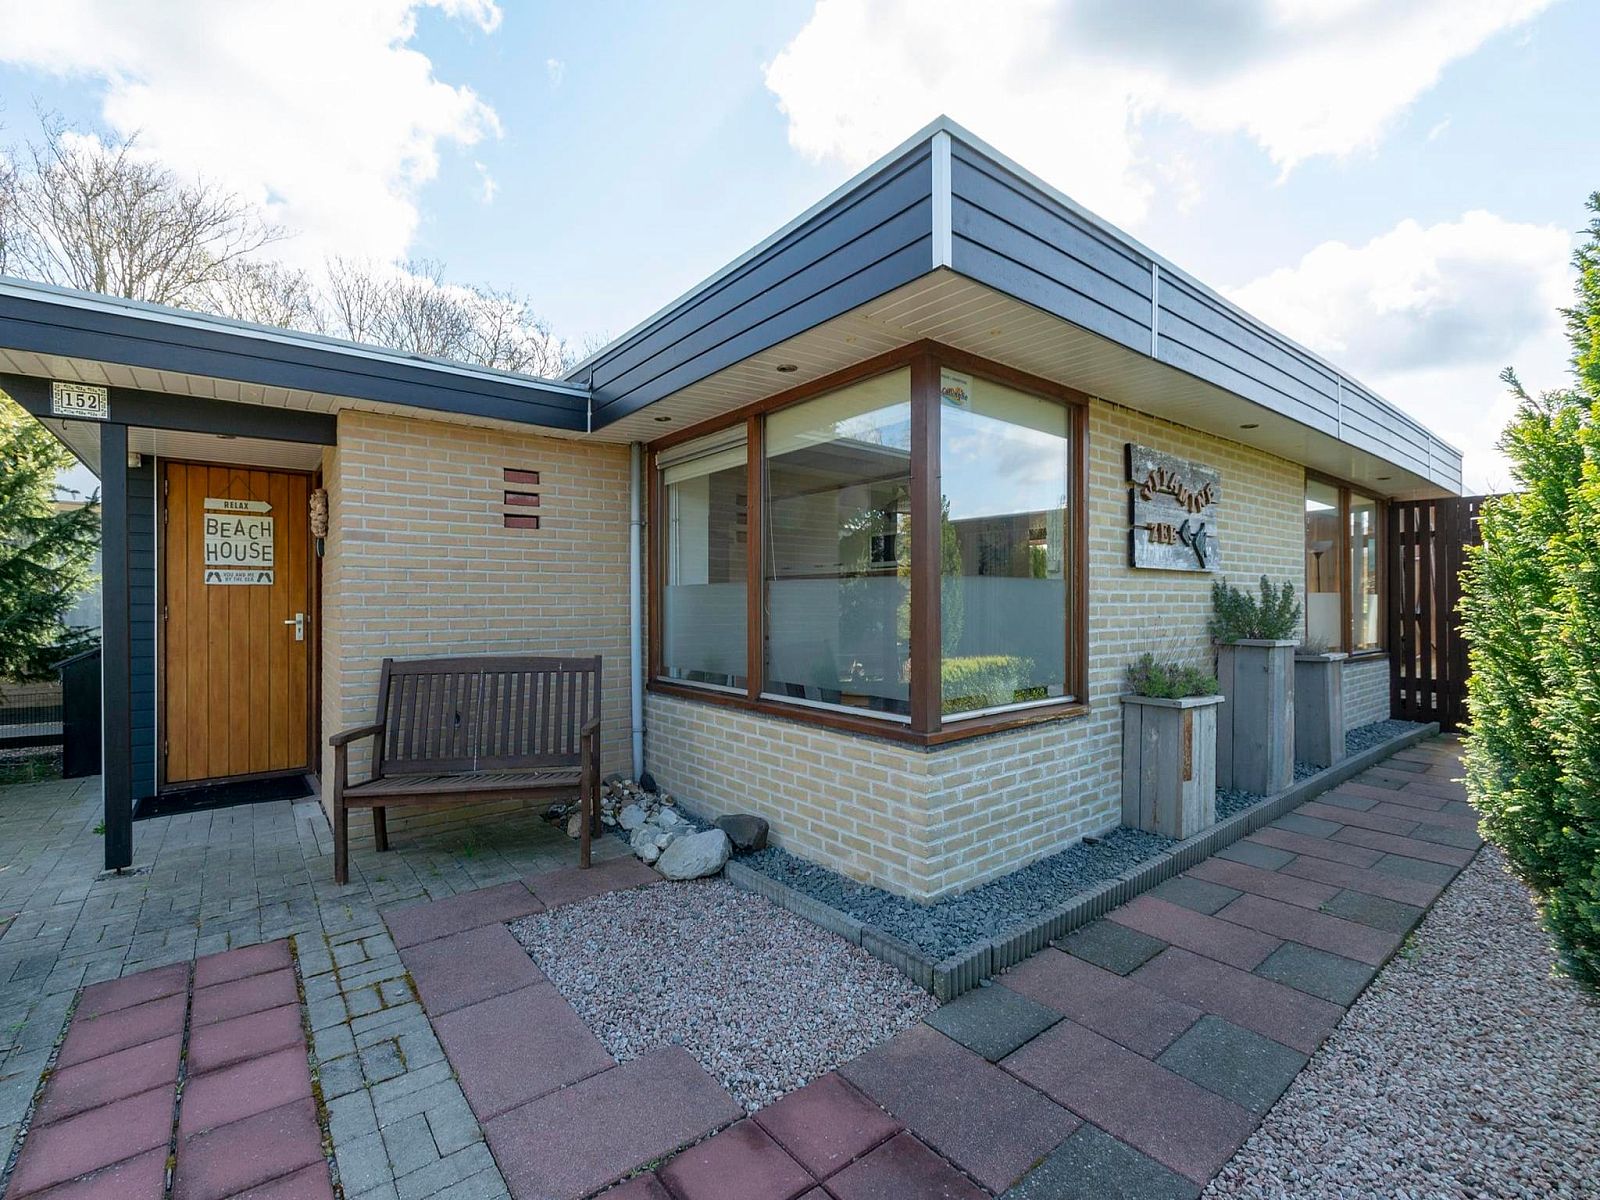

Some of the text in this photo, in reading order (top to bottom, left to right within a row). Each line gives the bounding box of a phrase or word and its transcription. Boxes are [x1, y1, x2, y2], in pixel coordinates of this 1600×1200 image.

[66, 393, 97, 408] 152
[1139, 467, 1216, 514] VITAMINE
[224, 501, 249, 510] RELAX
[206, 518, 271, 540] BEACH
[1147, 523, 1177, 545] ZEE
[206, 541, 272, 562] HOUSE
